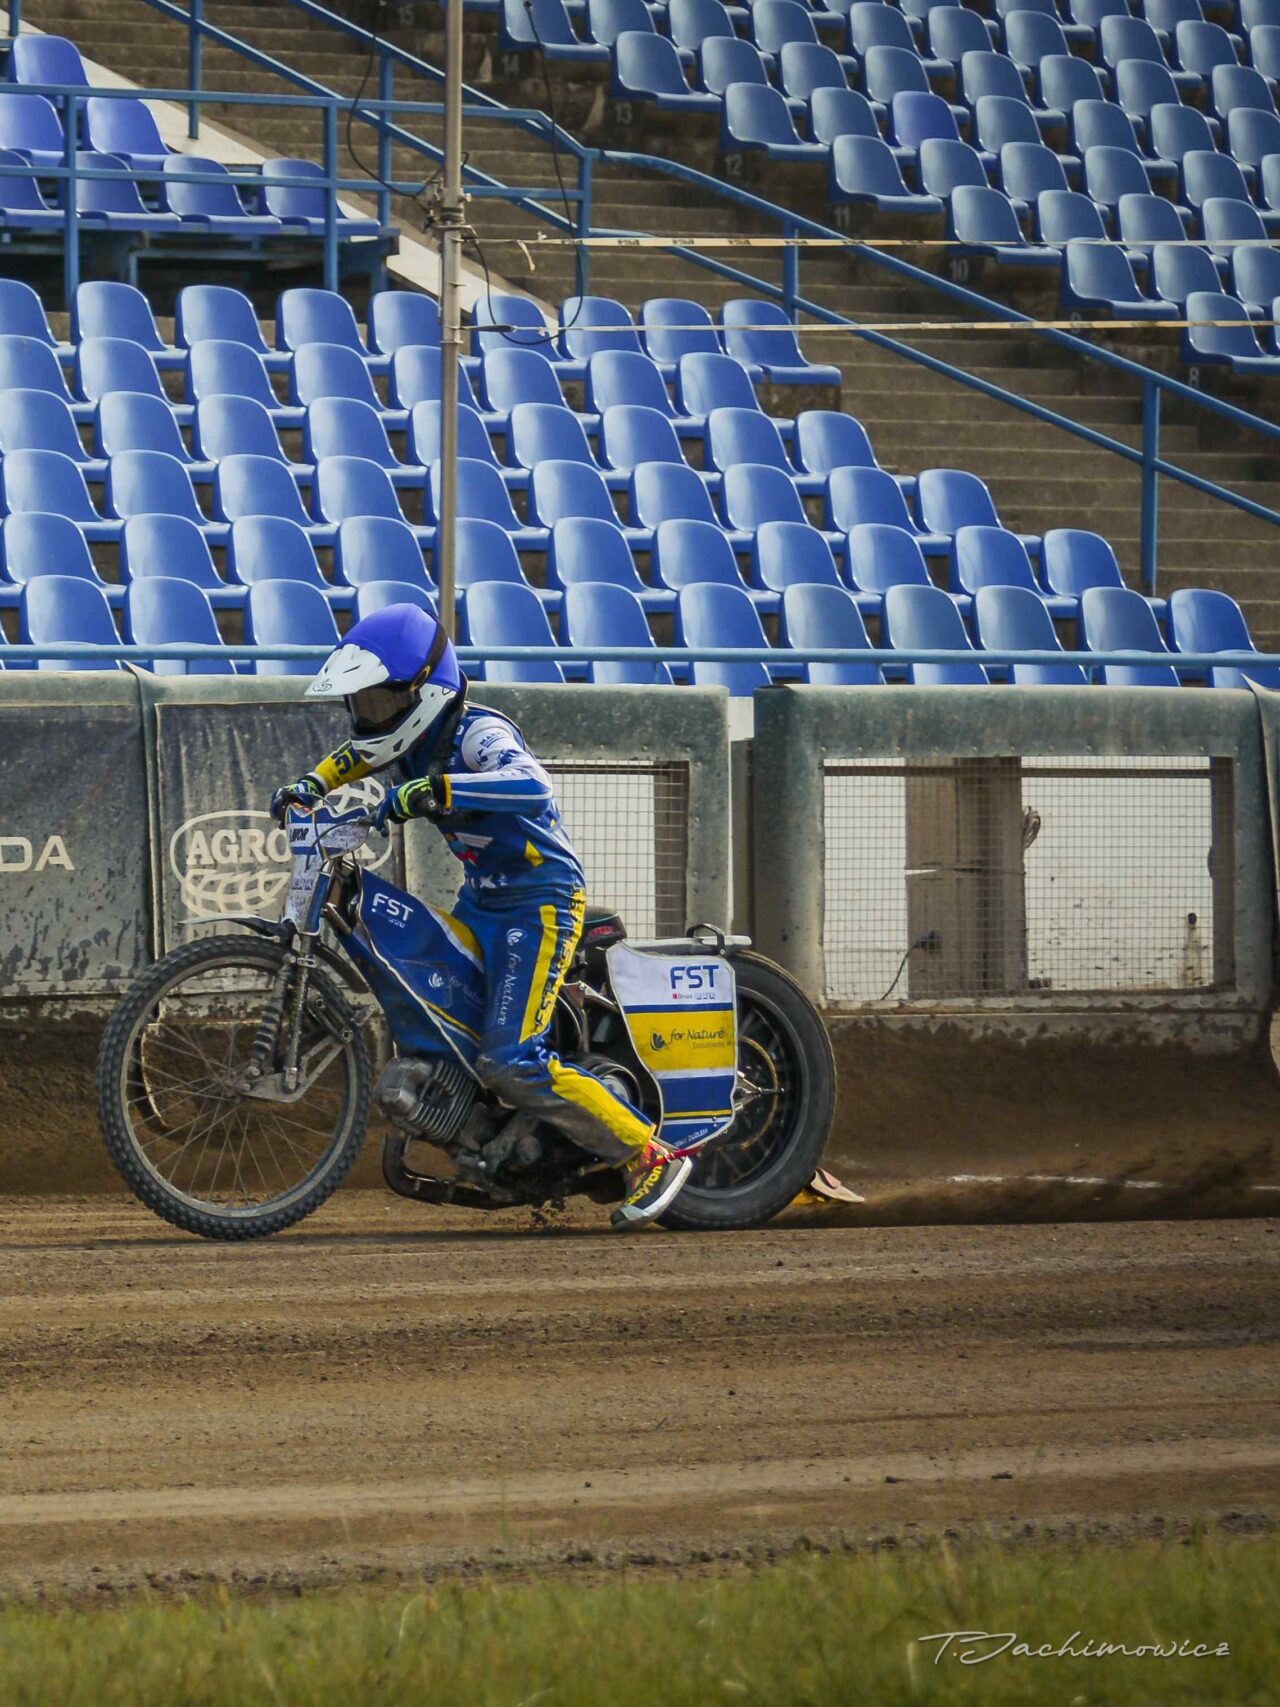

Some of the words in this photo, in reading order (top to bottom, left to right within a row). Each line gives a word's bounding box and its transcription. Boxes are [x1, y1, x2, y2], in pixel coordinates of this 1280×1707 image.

[501, 55, 518, 73] 14
[615, 104, 632, 124] 13
[724, 154, 742, 176] 12
[834, 207, 851, 227] 11
[949, 258, 969, 281] 10
[1188, 367, 1201, 388] 8
[371, 892, 414, 922] FST
[670, 964, 719, 990] FST
[667, 1028, 686, 1045] for
[687, 1027, 726, 1040] Nature
